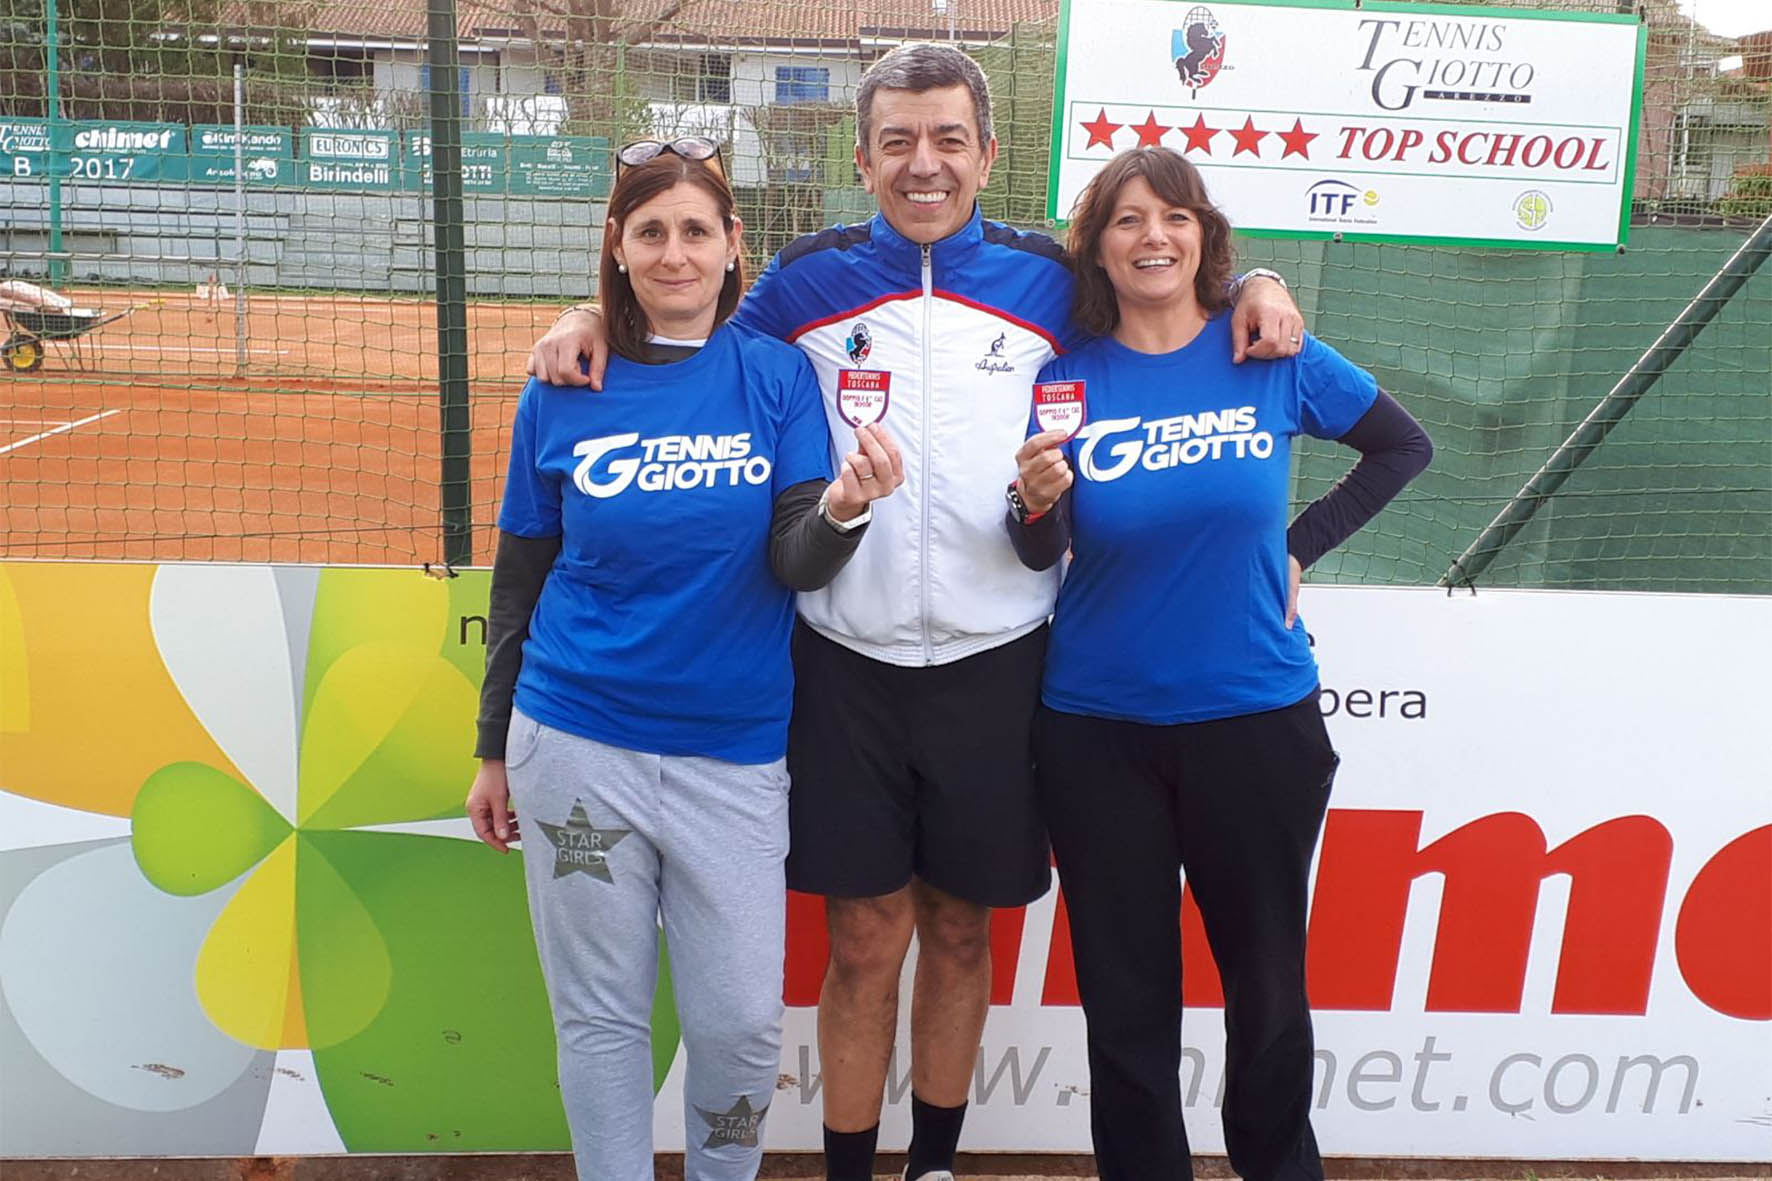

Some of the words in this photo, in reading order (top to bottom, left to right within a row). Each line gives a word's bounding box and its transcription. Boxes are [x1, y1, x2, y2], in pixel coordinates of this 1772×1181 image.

[1355, 19, 1507, 71] TENNIS
[1371, 58, 1534, 111] GIOTTO
[1438, 92, 1522, 103] AREZZO
[75, 127, 170, 150] chimet
[316, 139, 384, 154] EURONICS
[1336, 126, 1424, 163] TOP
[1427, 129, 1611, 172] SCHOOL
[14, 157, 31, 177] B
[70, 157, 135, 179] 2017
[310, 164, 389, 185] Birindelli
[1310, 192, 1358, 216] ITF
[848, 379, 880, 389] TOSCANA
[1042, 392, 1075, 402] TOSCANA
[1142, 406, 1257, 444] TENNIS
[640, 432, 751, 463] TENNIS
[1141, 431, 1274, 471] GIOTTO
[637, 455, 771, 491] GIOTTO
[556, 830, 602, 849] STAR
[558, 847, 604, 865] GIRLS
[716, 1115, 760, 1128] STAR
